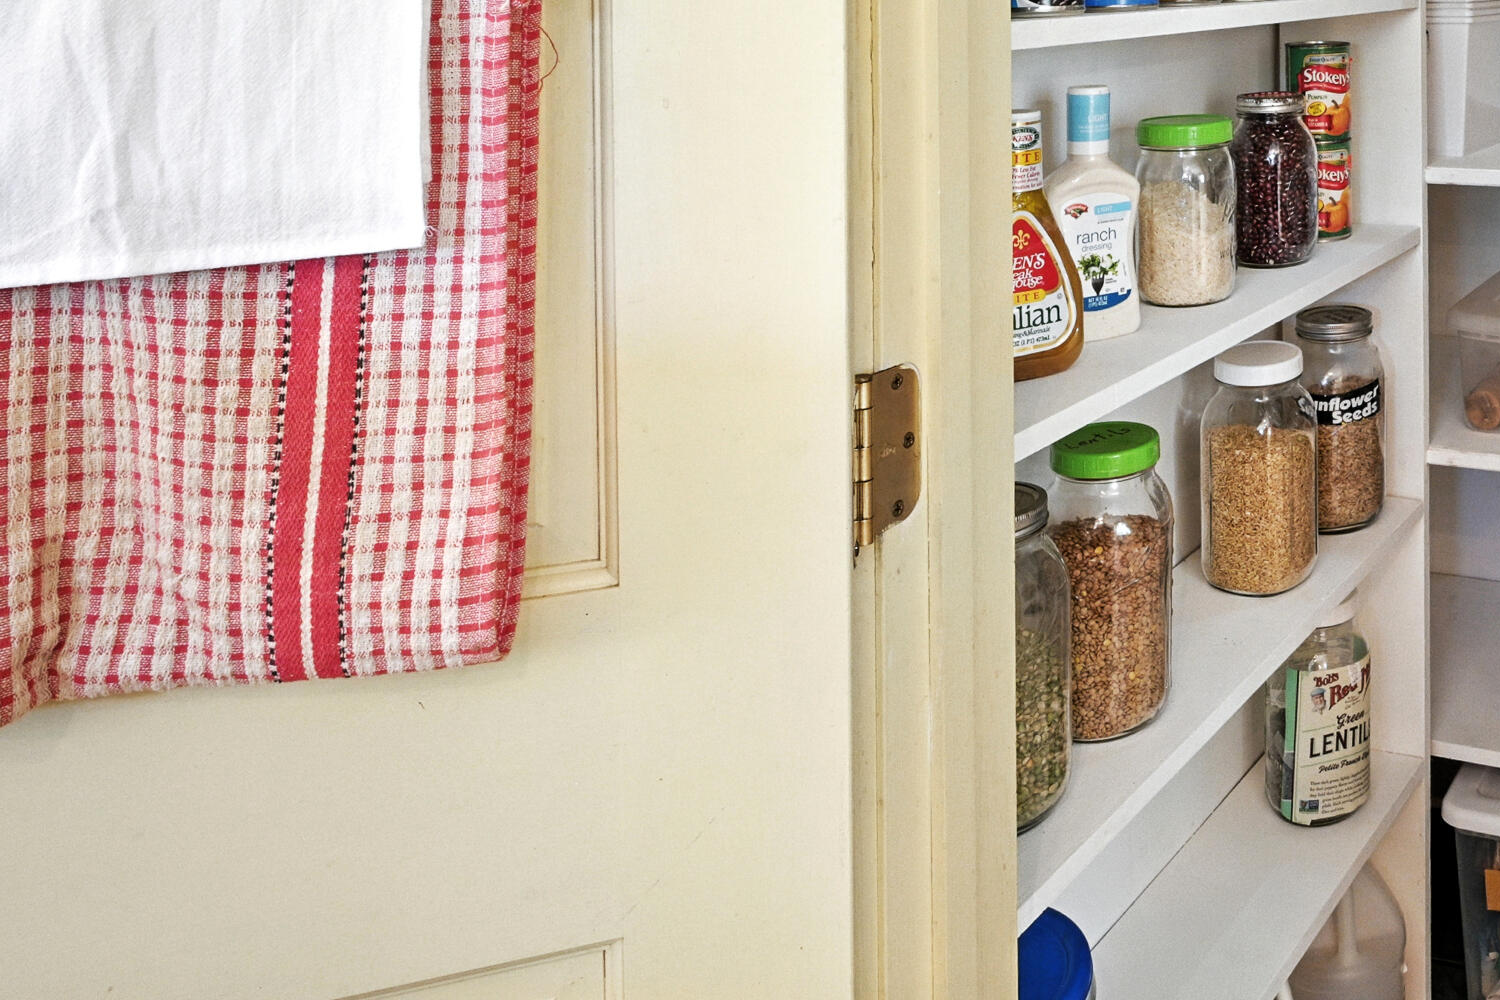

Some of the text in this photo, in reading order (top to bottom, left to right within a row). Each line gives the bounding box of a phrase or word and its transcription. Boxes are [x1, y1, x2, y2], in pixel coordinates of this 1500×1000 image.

[1303, 68, 1350, 87] Stokely's
[1014, 151, 1041, 164] ITE
[1318, 168, 1349, 184] okely's
[1076, 227, 1117, 245] ranch
[1081, 241, 1113, 253] dressing
[1013, 252, 1046, 271] EN'S
[1013, 268, 1033, 280] eak
[1015, 291, 1040, 303] ITE
[1013, 304, 1062, 331] lian
[1332, 401, 1378, 425] Seeds
[1336, 710, 1365, 730] Green
